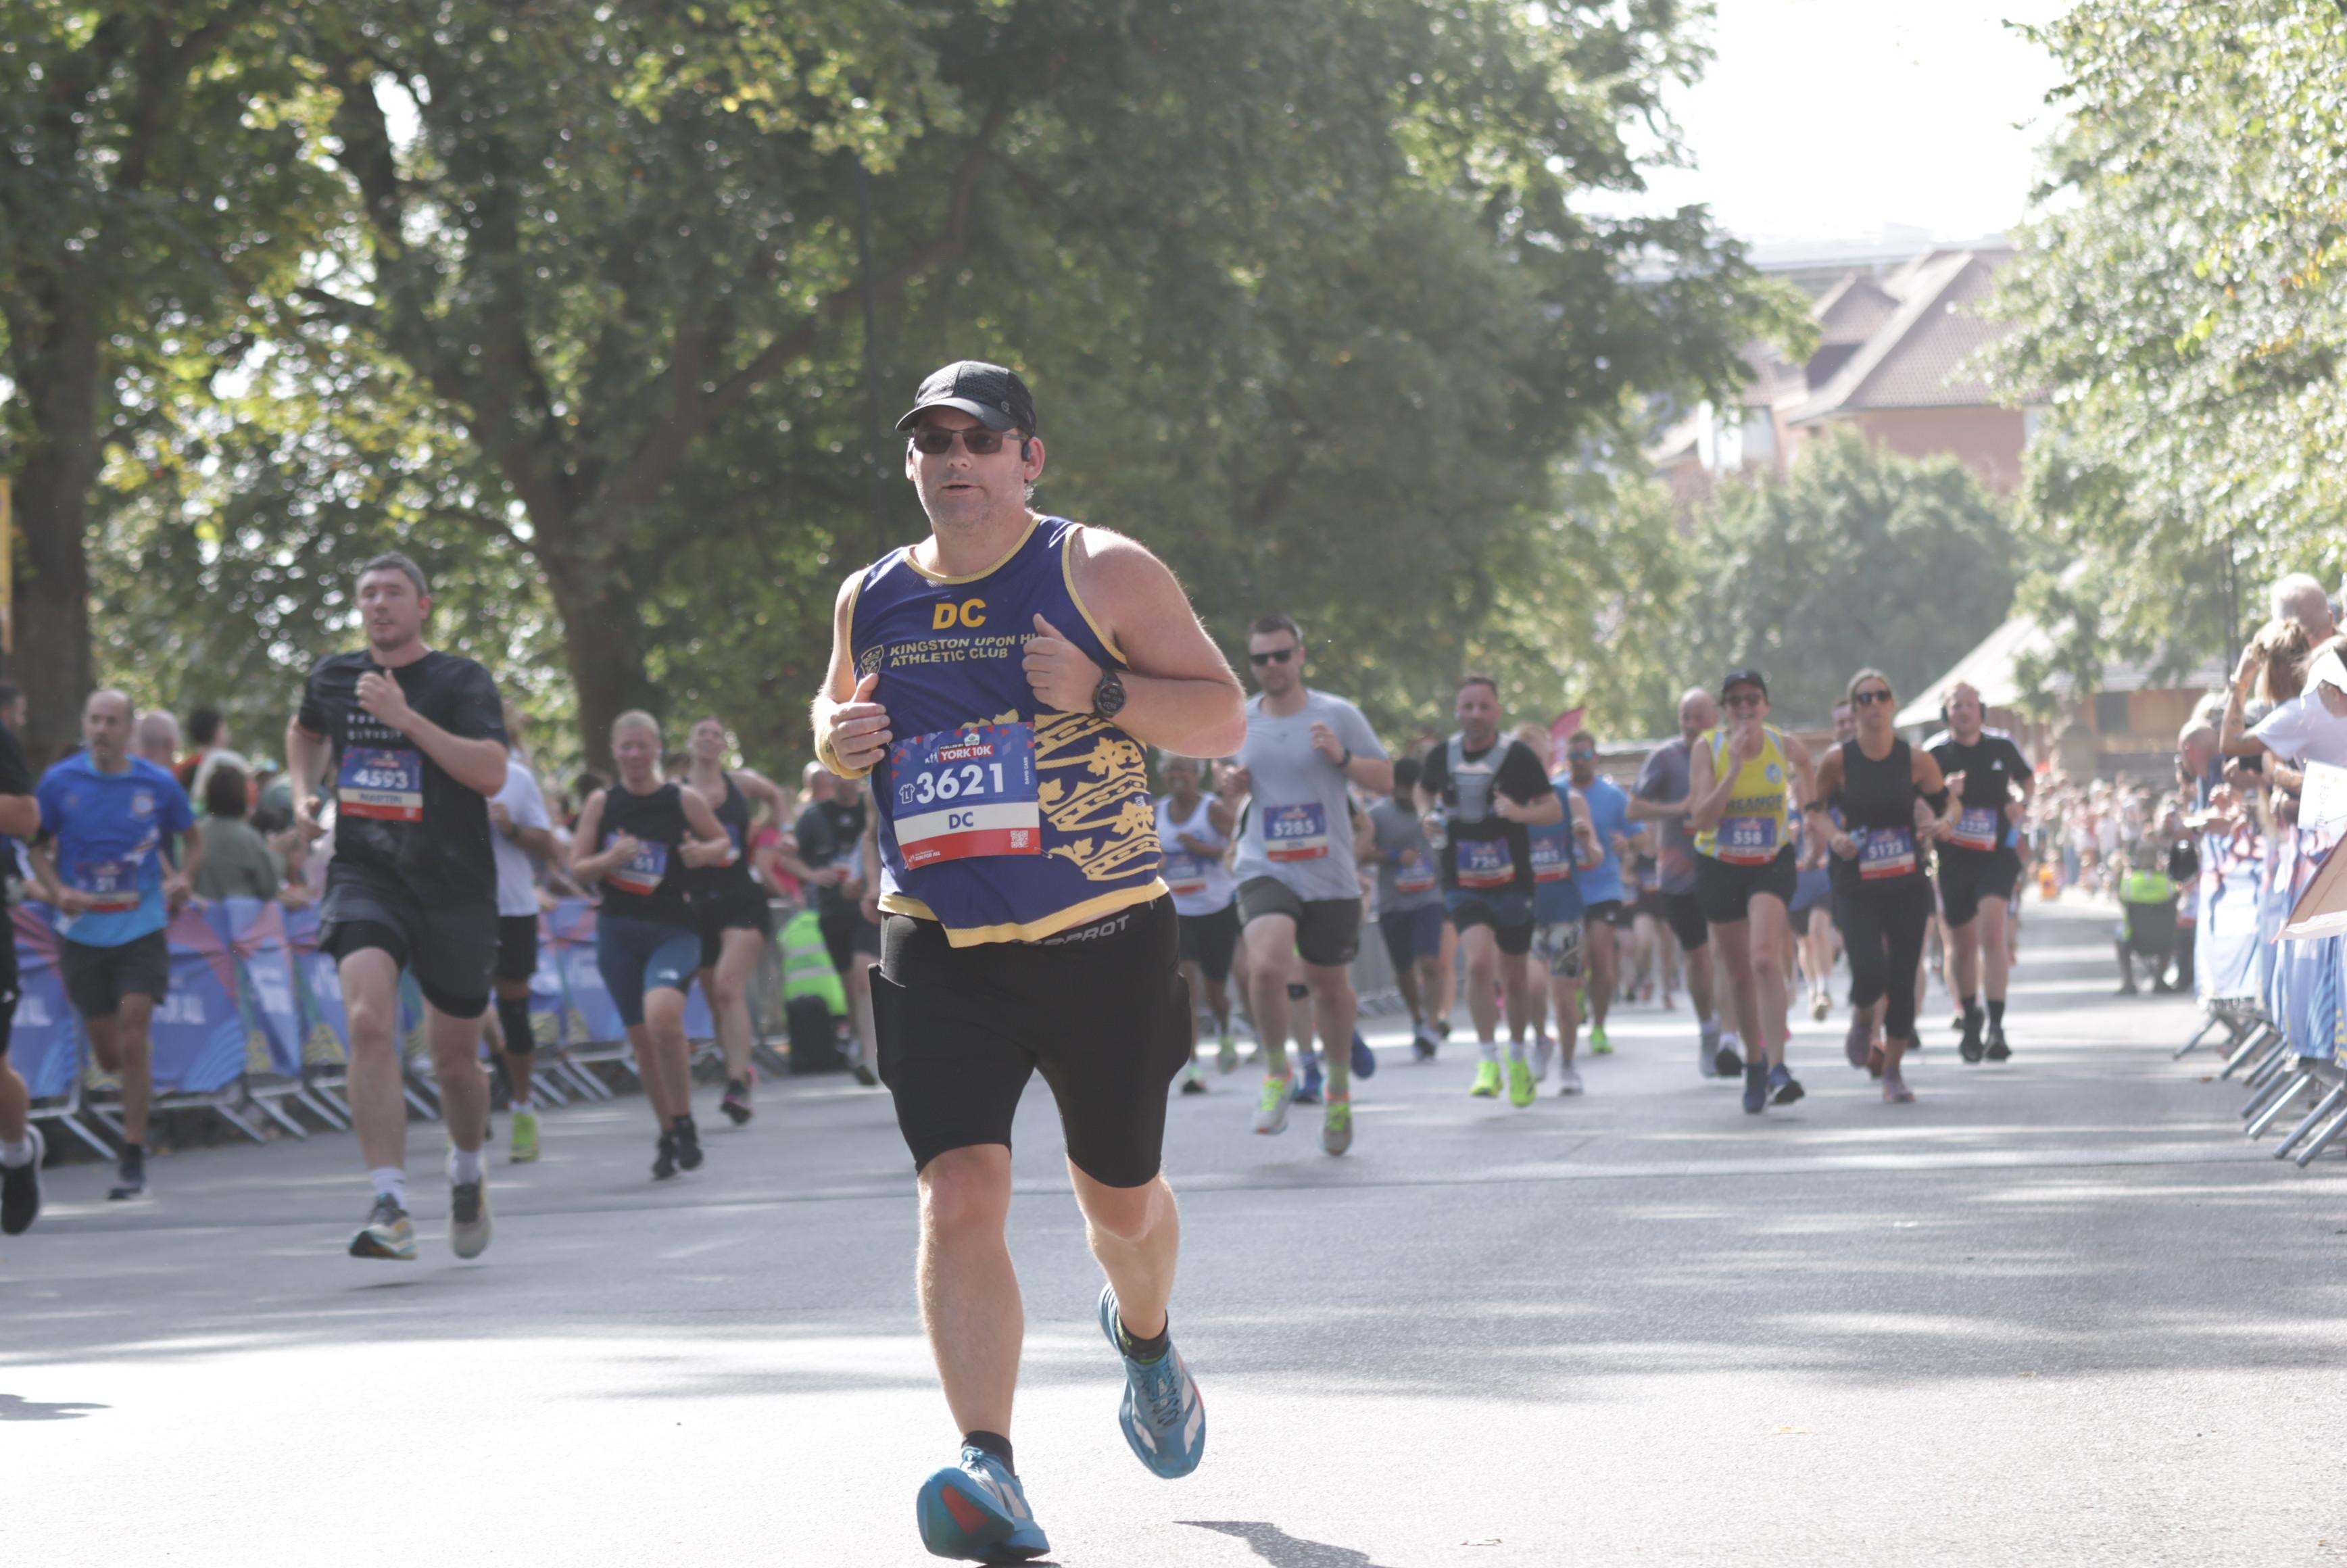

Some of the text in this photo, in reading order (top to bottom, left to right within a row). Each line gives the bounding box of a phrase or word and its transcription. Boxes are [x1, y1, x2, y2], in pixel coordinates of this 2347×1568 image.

[932, 598, 986, 630] DC
[890, 638, 969, 656] KINGSTON
[975, 635, 1015, 646] UPON
[890, 647, 1008, 668] ATHLETIC CLUB
[941, 745, 992, 761] YORK 10K
[354, 769, 408, 789] 4593
[916, 762, 1004, 804] 3621
[948, 811, 973, 829] DC
